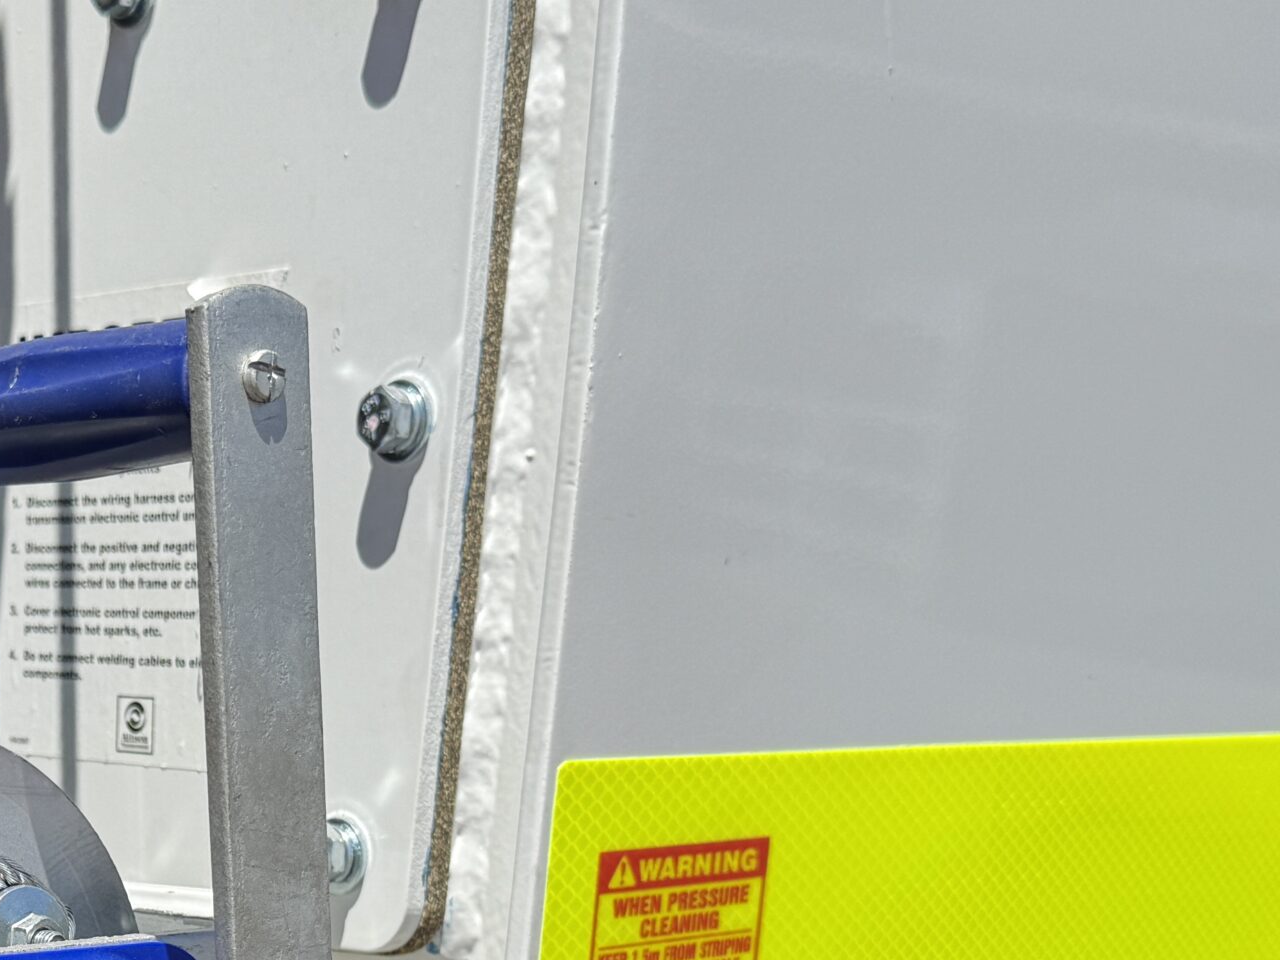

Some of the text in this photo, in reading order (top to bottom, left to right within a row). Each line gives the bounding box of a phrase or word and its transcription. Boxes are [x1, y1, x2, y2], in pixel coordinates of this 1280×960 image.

[82, 494, 97, 506] the
[100, 493, 131, 508] wiring
[133, 492, 175, 504] harness
[88, 511, 140, 524] electronic
[142, 509, 179, 522] control
[81, 541, 96, 553] the
[98, 541, 138, 556] positive
[141, 541, 159, 552] and
[87, 559, 106, 571] and
[108, 561, 126, 573] any
[129, 559, 181, 571] electronic
[53, 577, 103, 589] connected
[105, 577, 117, 589] to
[119, 577, 135, 589] the
[137, 577, 168, 589] frame
[171, 579, 182, 589] or
[53, 606, 101, 618] electronic
[104, 607, 140, 619] control
[24, 624, 58, 636] protect
[84, 625, 101, 636] hot
[103, 625, 140, 638] sparks,
[142, 626, 163, 637] etc.
[23, 650, 36, 662] Do
[39, 651, 53, 662] not
[97, 653, 136, 668] welding
[138, 655, 172, 668] cables
[175, 657, 187, 668] to
[639, 847, 758, 882] WARNING
[613, 884, 751, 918] WHEN PRESSURE
[640, 911, 720, 938] CLEANING
[700, 935, 752, 959] STRIPING
